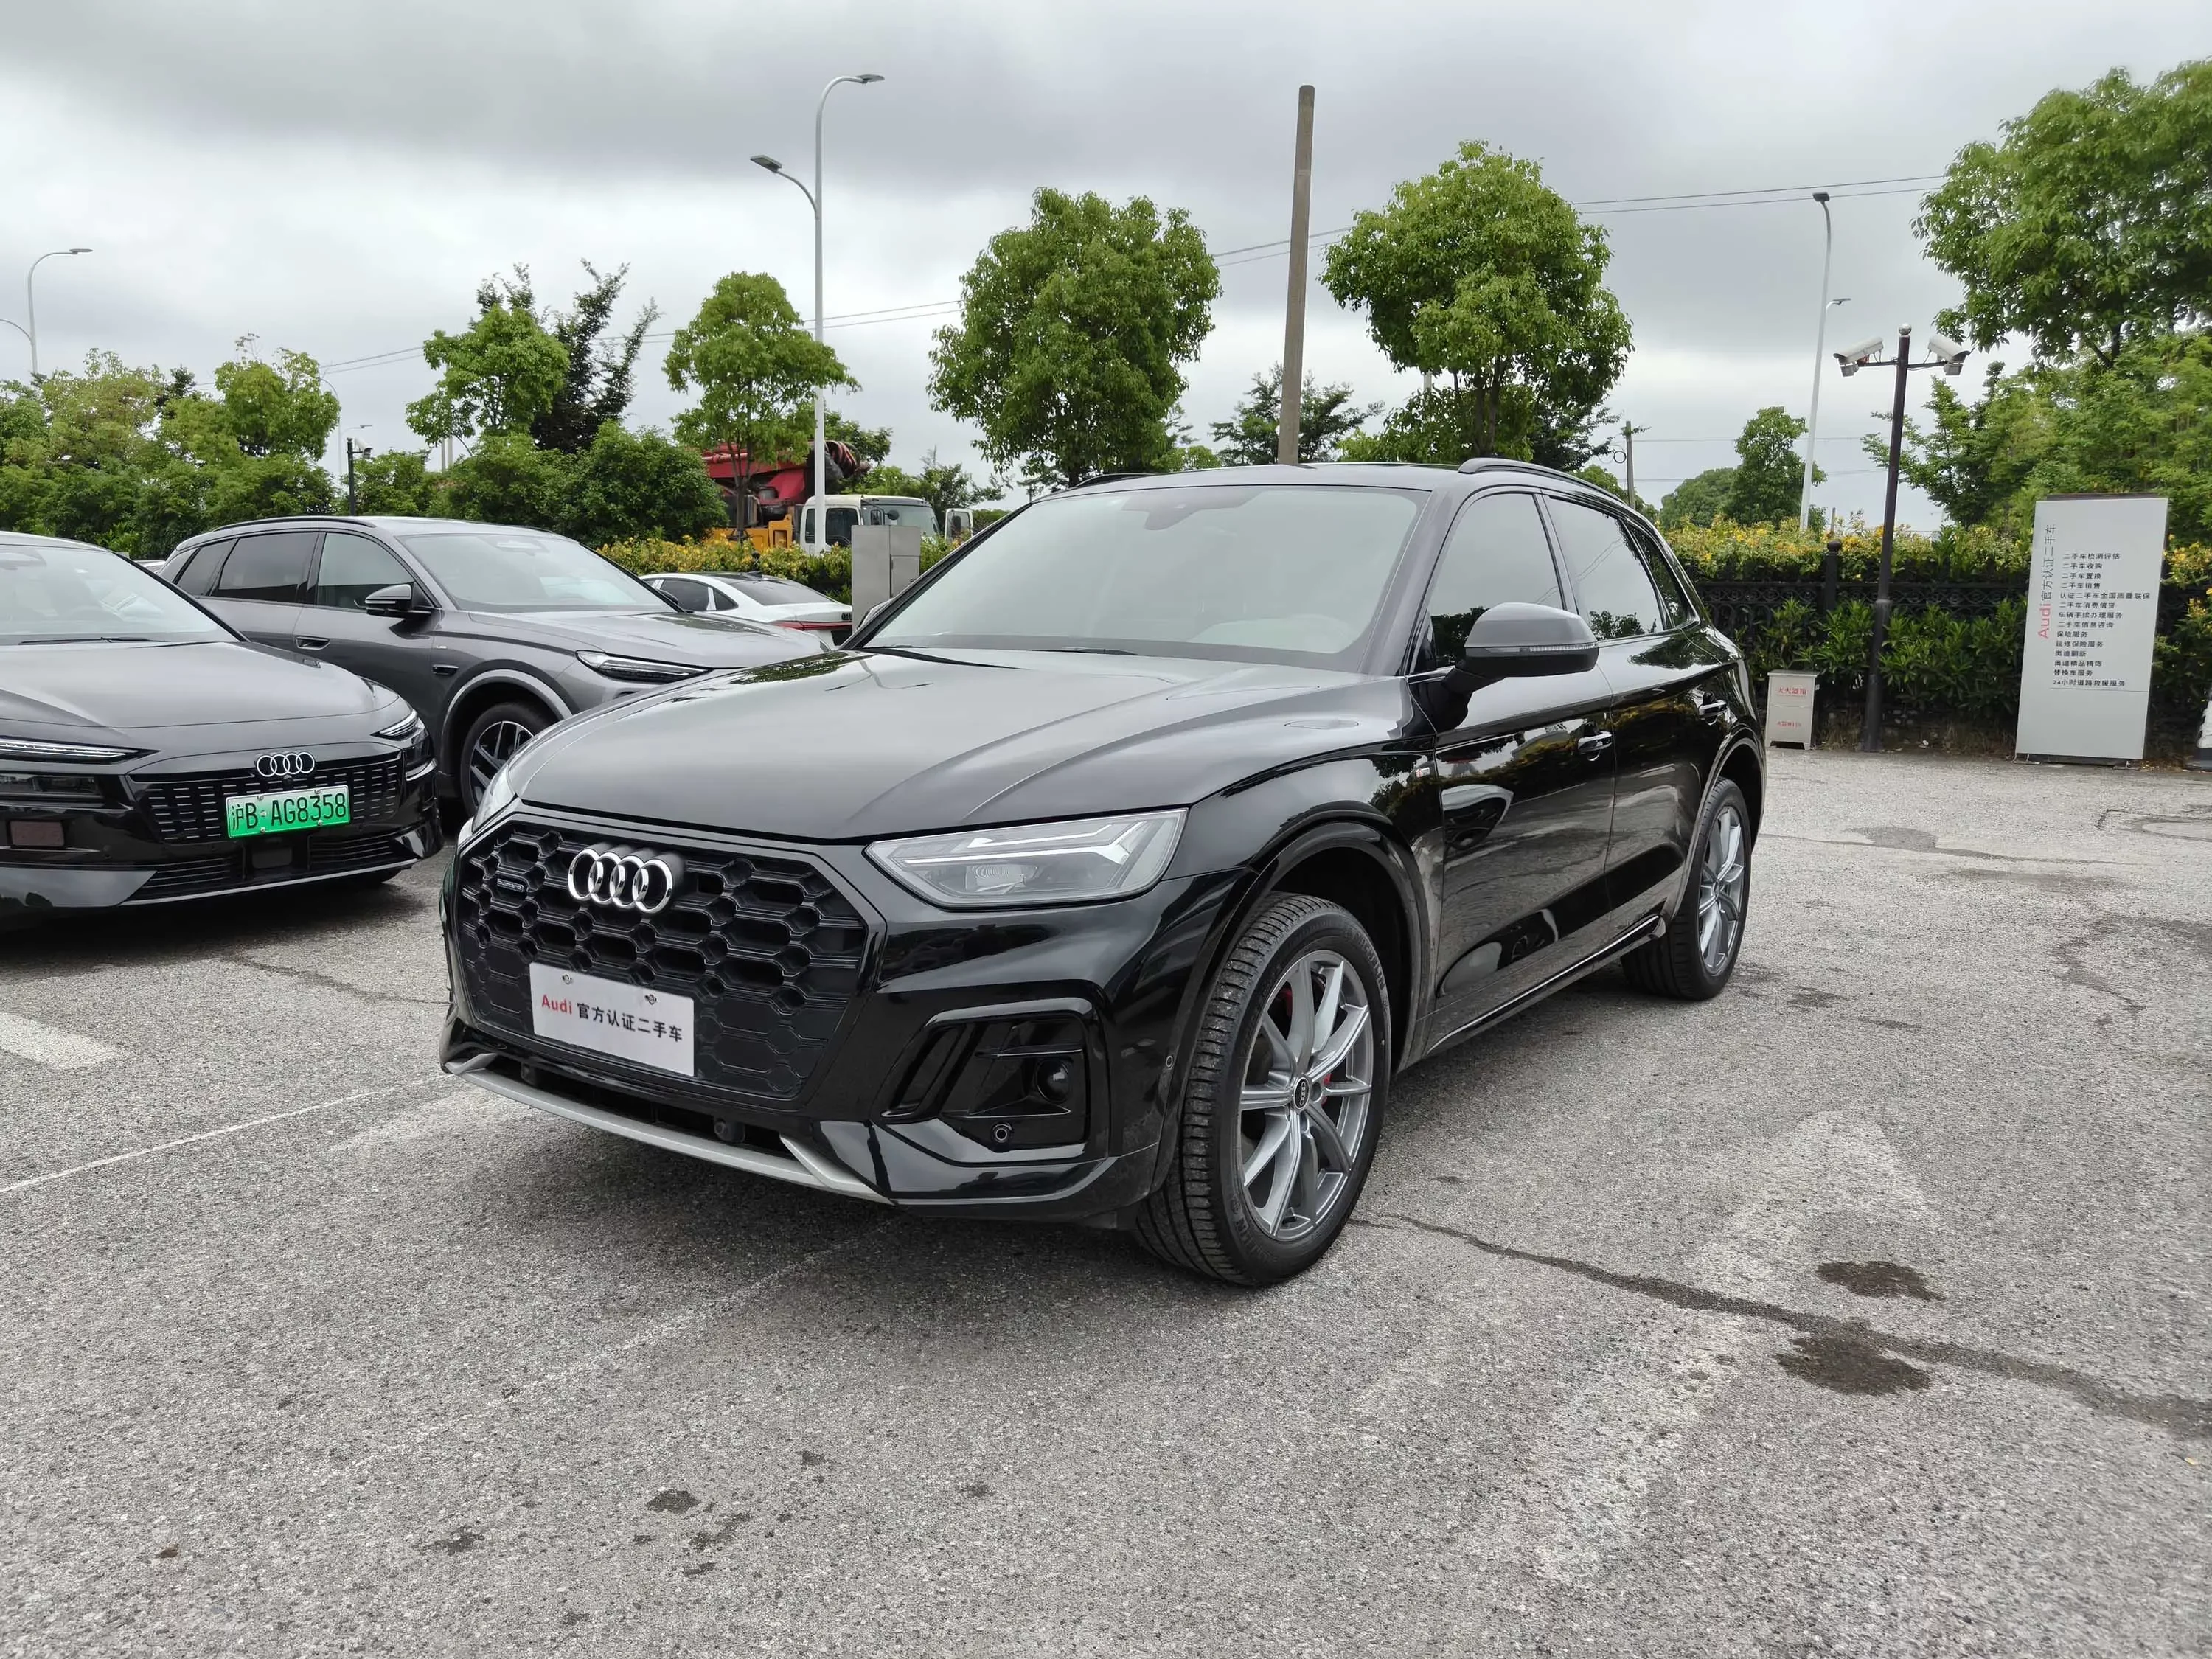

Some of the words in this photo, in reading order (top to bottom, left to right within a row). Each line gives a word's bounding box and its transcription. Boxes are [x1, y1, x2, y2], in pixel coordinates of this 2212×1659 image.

[2041, 524, 2057, 602] 官方认证二手车
[2037, 603, 2052, 639] Audi
[232, 802, 258, 830] 沪B
[271, 793, 347, 827] AG8358
[541, 994, 573, 1015] Audi
[577, 1001, 683, 1042] 官方认证二手车
